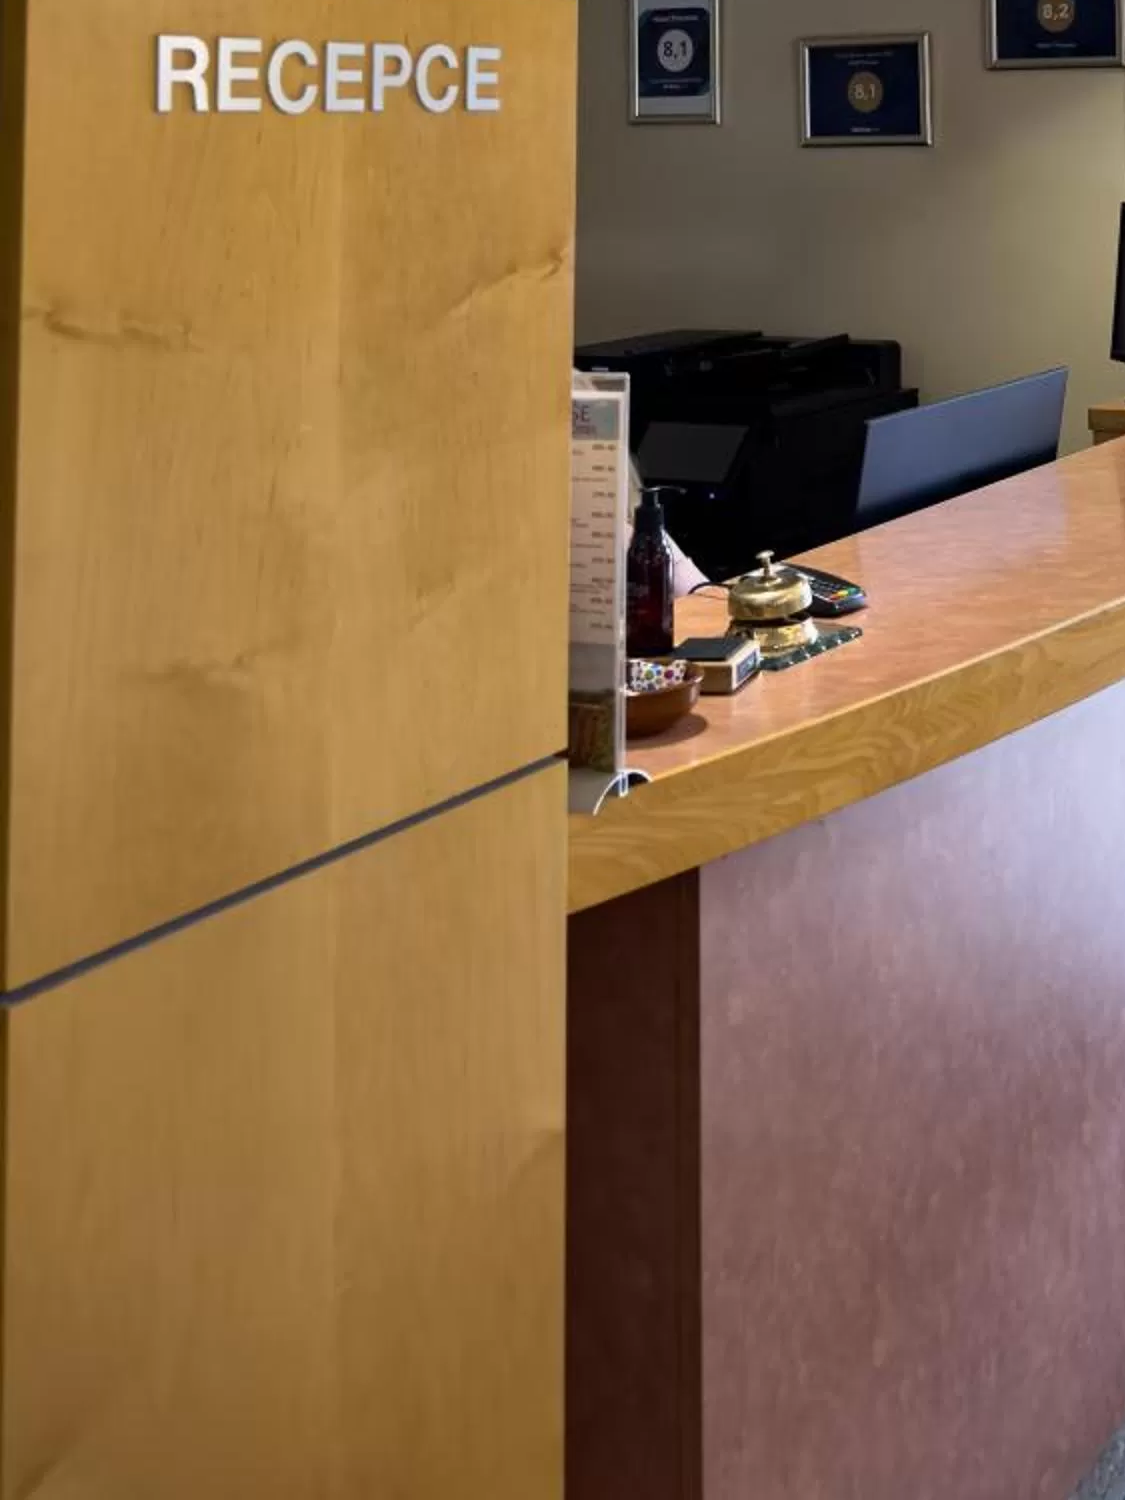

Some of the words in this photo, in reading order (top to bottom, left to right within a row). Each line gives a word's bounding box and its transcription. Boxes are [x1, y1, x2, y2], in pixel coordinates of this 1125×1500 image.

[1043, 3, 1070, 21] 8,2
[663, 40, 688, 59] 8,1
[156, 33, 502, 116] RECEPCE
[854, 83, 876, 100] 8,1
